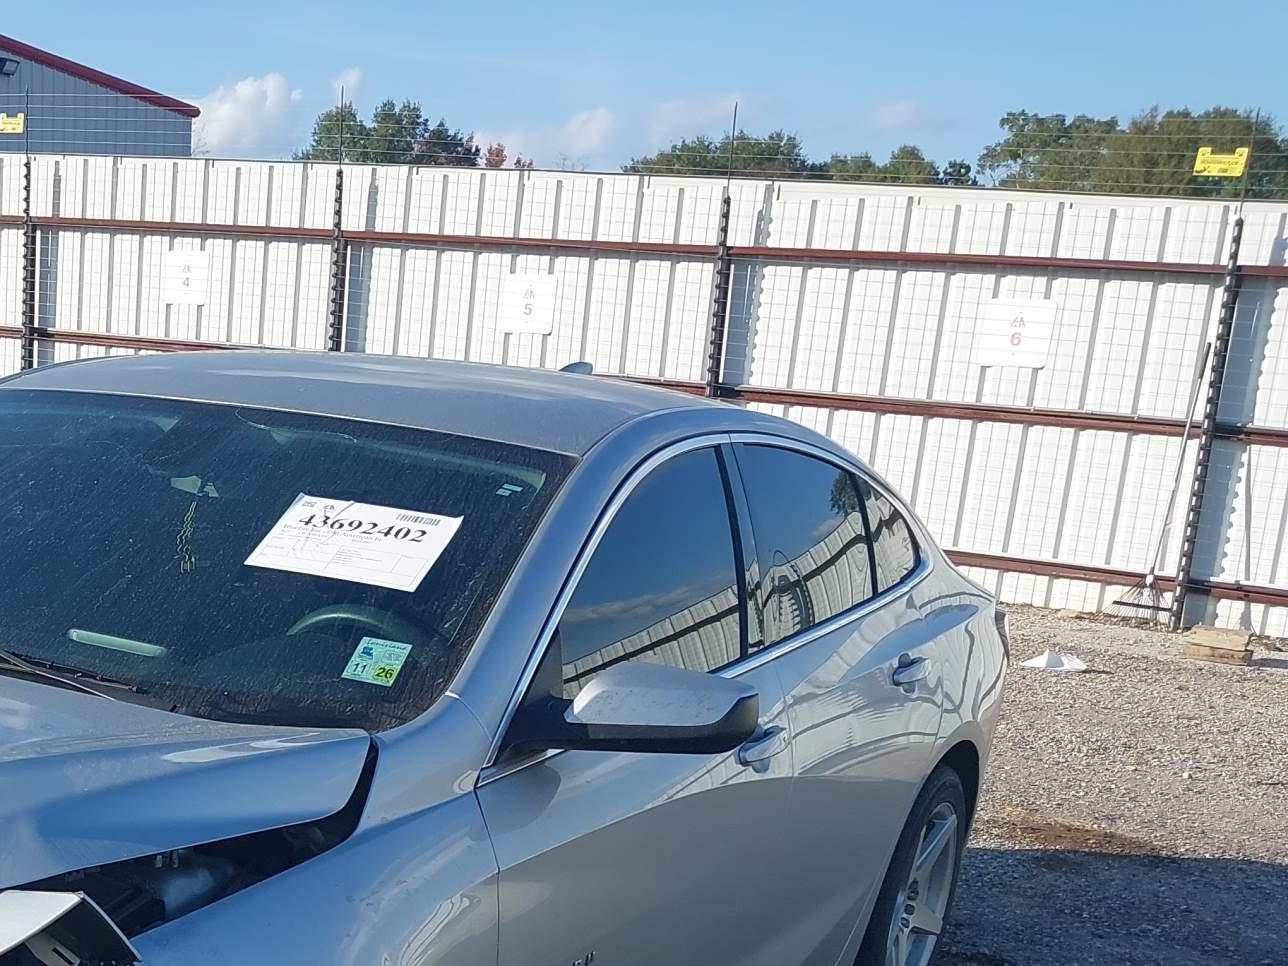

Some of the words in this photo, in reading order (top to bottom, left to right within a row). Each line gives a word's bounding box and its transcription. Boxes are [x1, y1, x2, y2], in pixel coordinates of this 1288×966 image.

[182, 277, 190, 288] 4
[523, 303, 533, 316] 5
[1010, 332, 1022, 346] 6
[298, 514, 428, 543] 43692402
[353, 662, 368, 674] 11
[375, 667, 395, 679] 26
